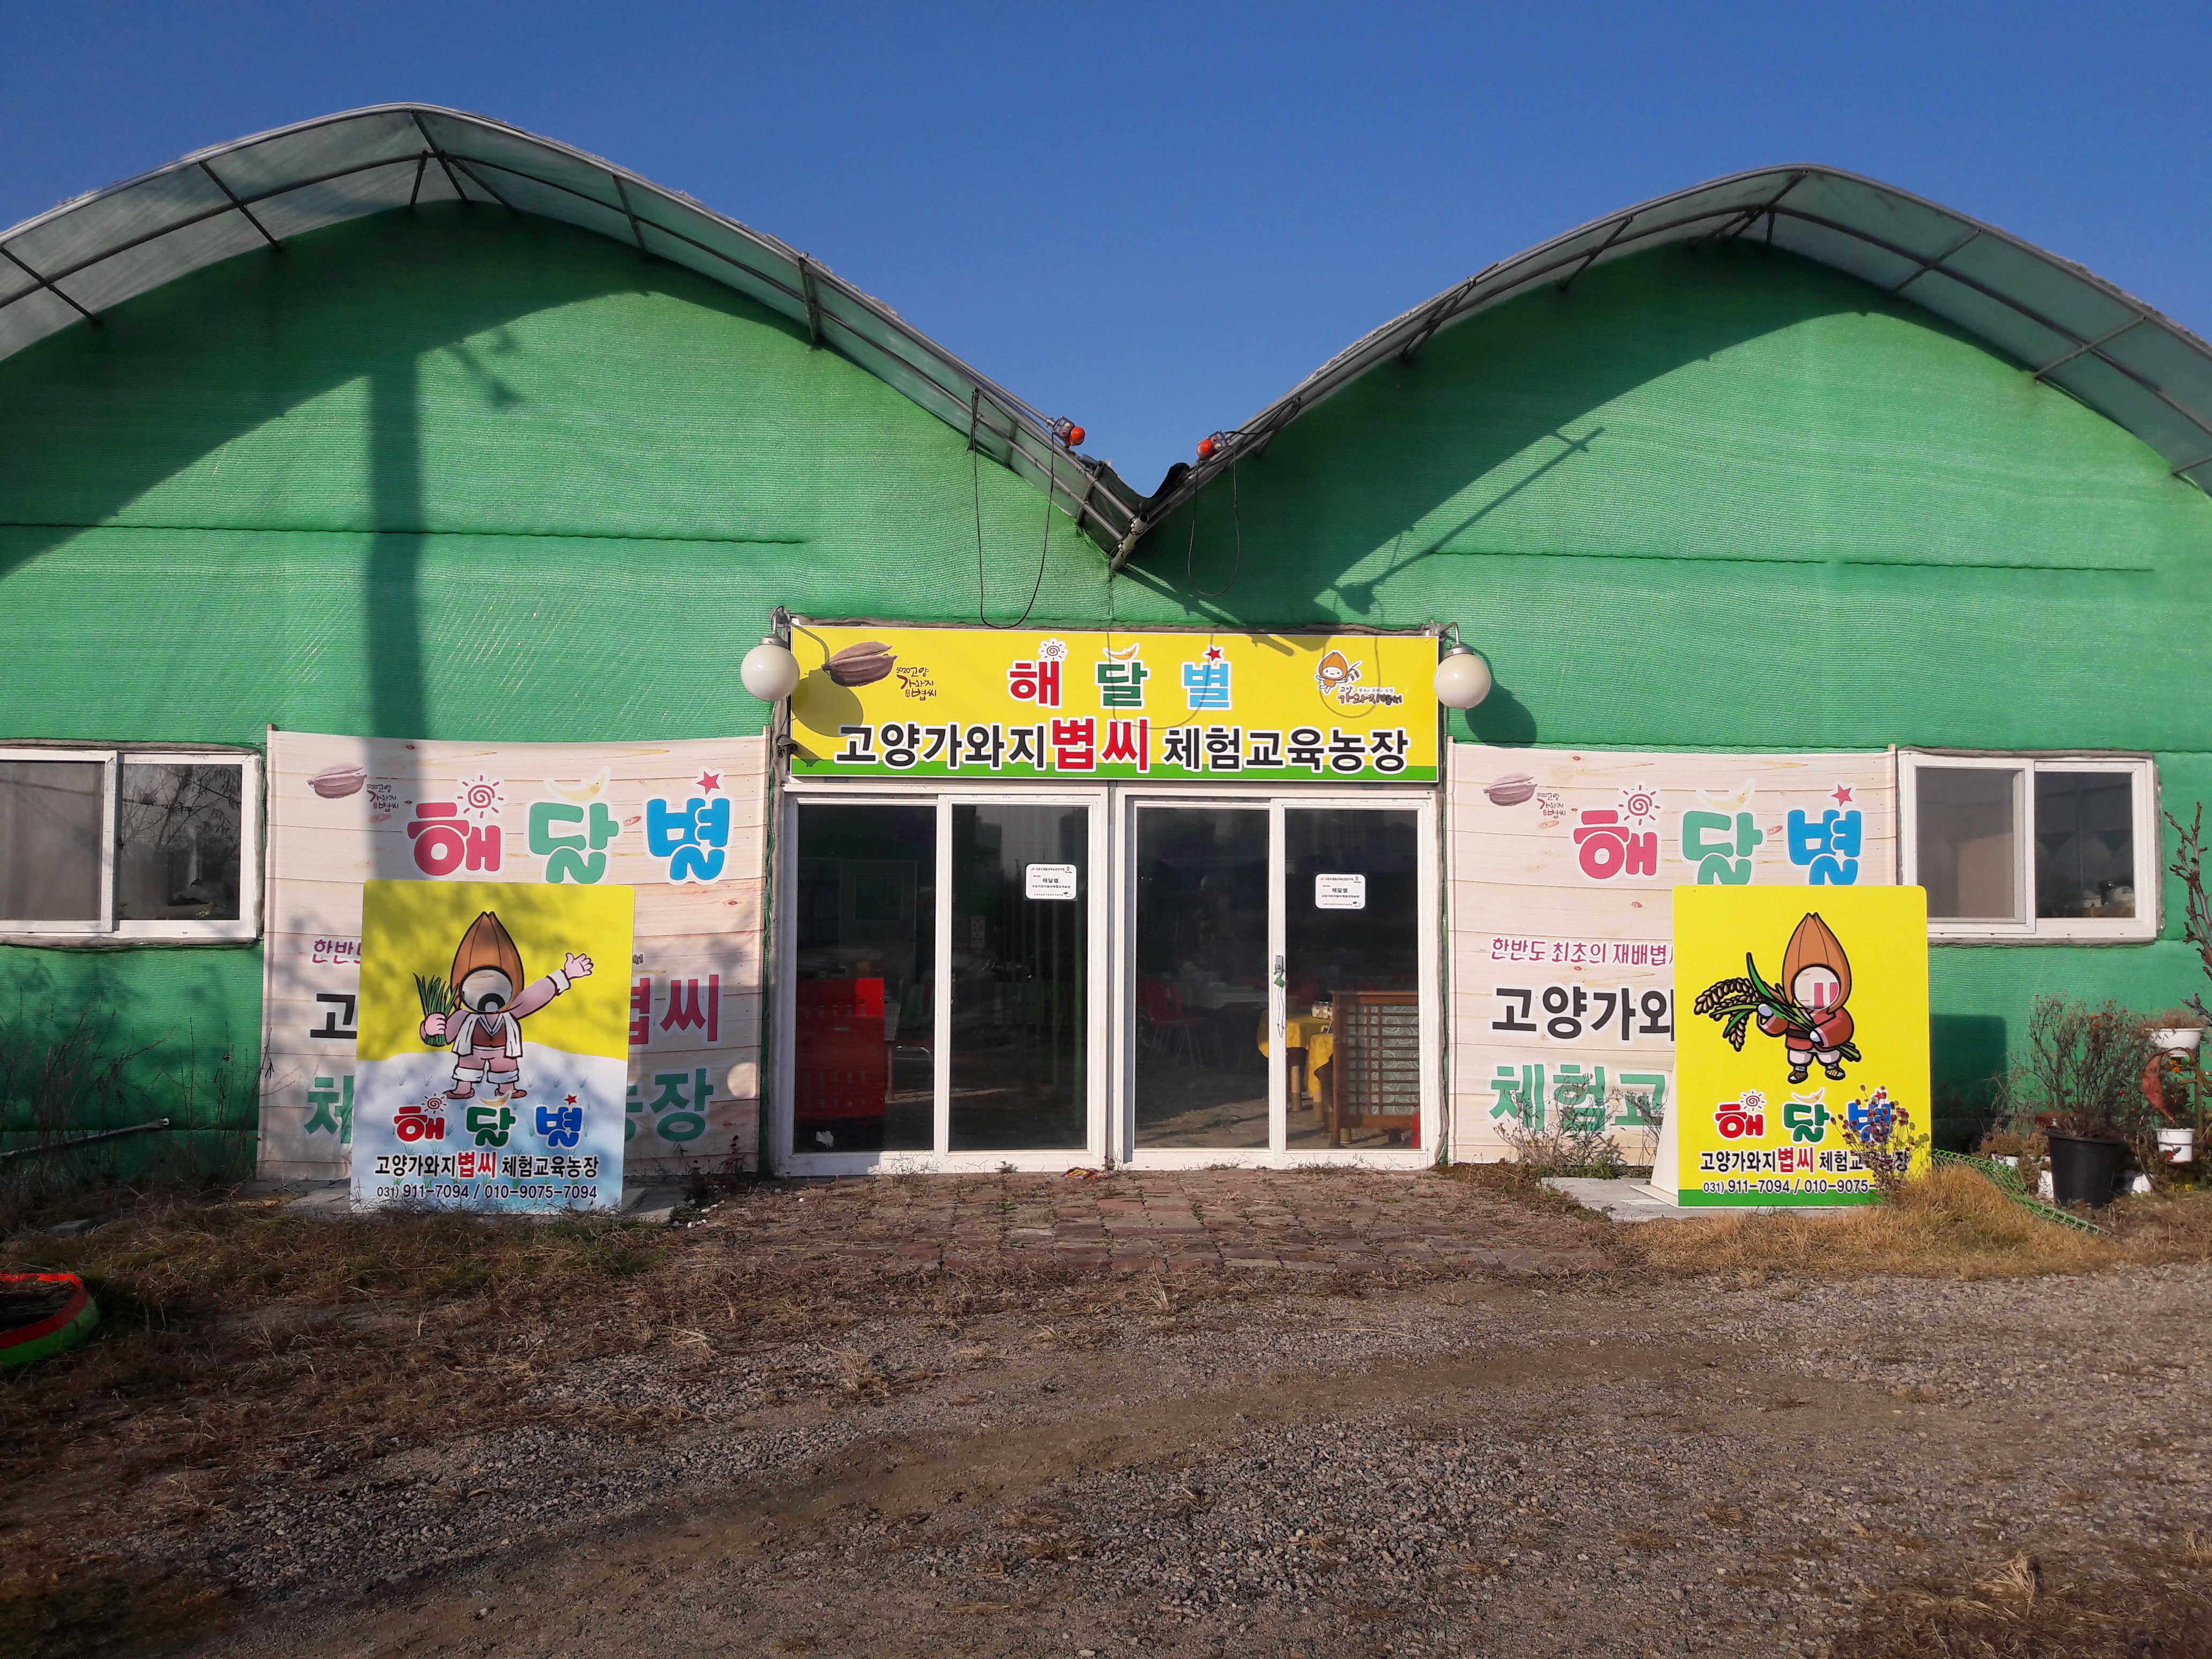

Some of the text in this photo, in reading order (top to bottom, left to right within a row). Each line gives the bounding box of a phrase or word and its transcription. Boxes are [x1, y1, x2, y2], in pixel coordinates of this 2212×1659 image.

[896, 674, 934, 690] 가와지
[911, 687, 937, 701] 볍씨
[1010, 661, 1230, 708] 해 달 별
[836, 719, 1408, 771] 고양가와지볍씨 체험교육농장
[407, 797, 730, 883] 해 달 별
[1573, 809, 1862, 885] 해 달 별
[1491, 937, 1673, 966] 한반도 최초의 재배볍
[394, 1106, 582, 1147] 해 달 별
[1715, 1103, 1763, 1138] 해
[1784, 1103, 1830, 1142] 달
[375, 1152, 599, 1178] 고양가와지볍씨 체험교육농장
[1700, 1147, 1813, 1173] 고양가와지볍씨
[377, 1186, 399, 1199] 031)
[403, 1184, 469, 1199] 911-7094
[484, 1185, 597, 1199] 010-9075-7094
[1703, 1182, 1724, 1194] 031)
[1728, 1179, 1790, 1194] 911-7094
